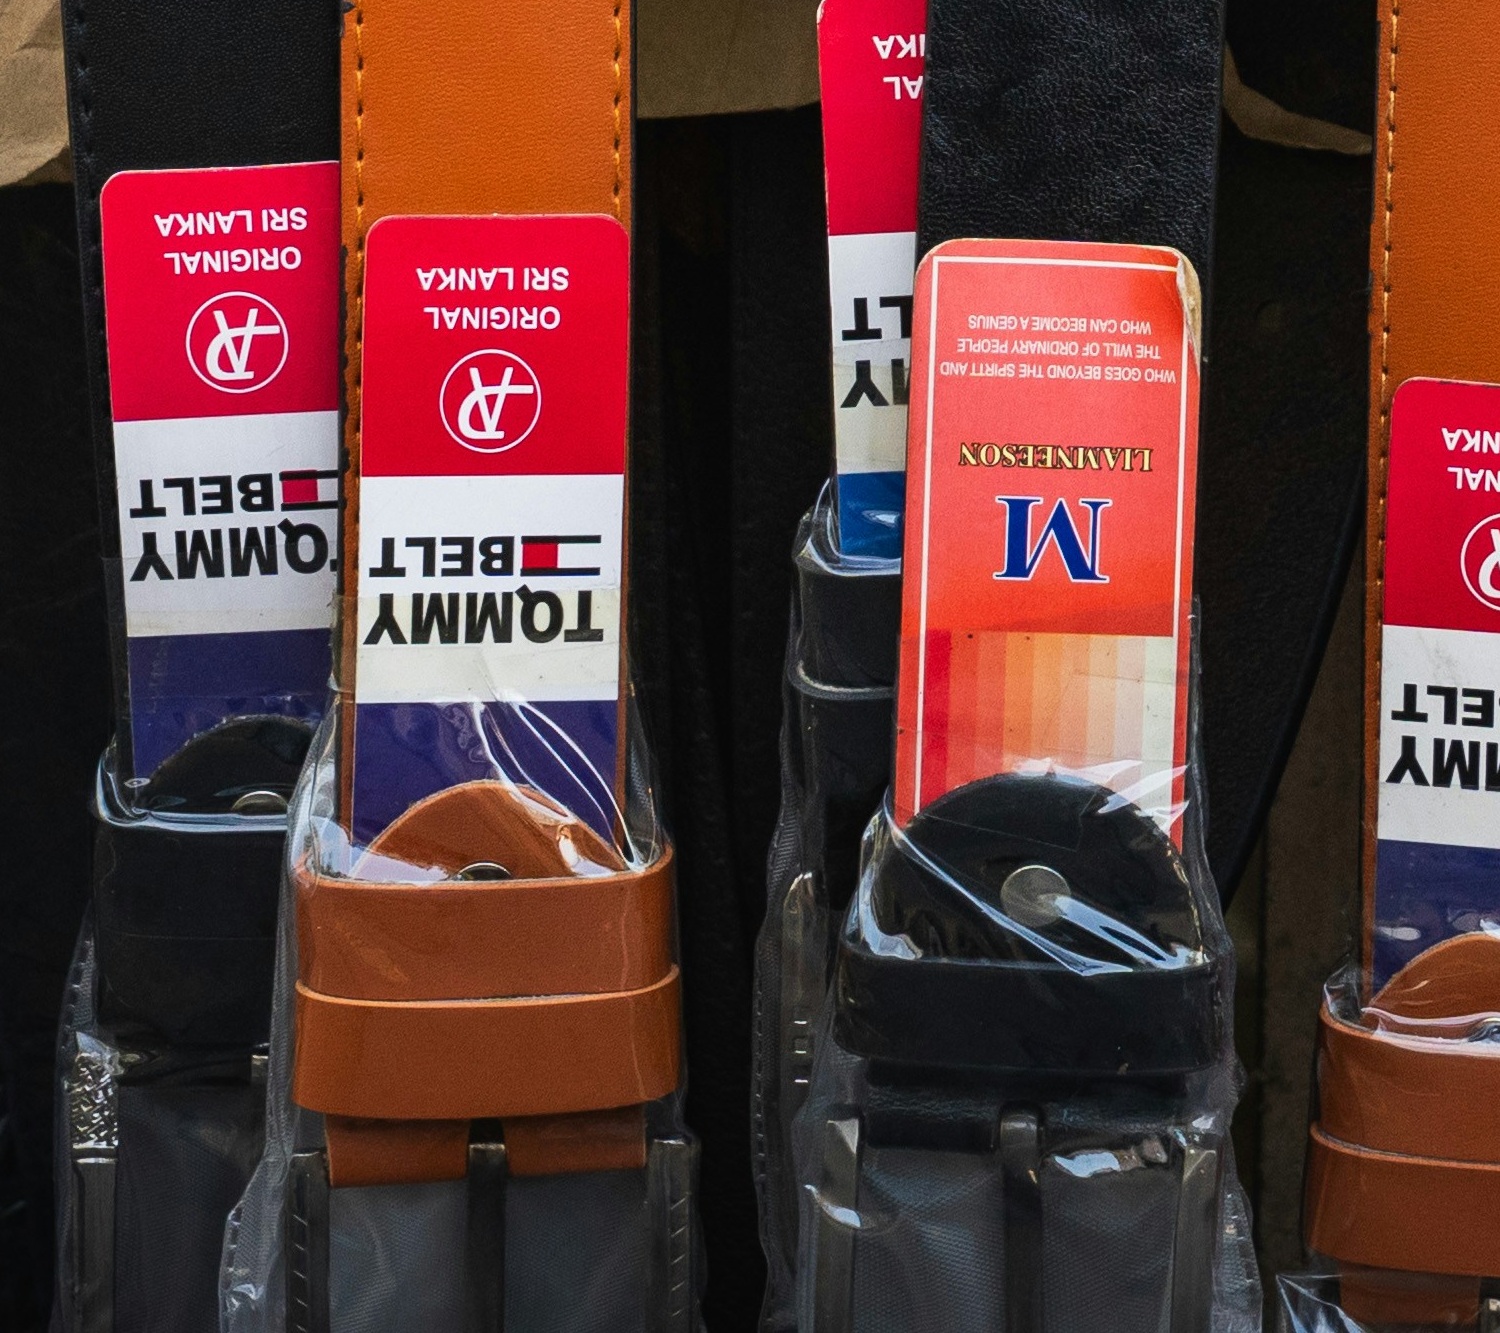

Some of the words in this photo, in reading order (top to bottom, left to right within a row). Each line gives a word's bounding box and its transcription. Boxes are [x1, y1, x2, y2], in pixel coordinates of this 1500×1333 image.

[154, 209, 254, 239] LANKA
[261, 205, 309, 234] SRI
[163, 244, 304, 274] ORIGINAL
[415, 265, 514, 291] LANKA
[519, 266, 570, 292] SRI
[422, 304, 562, 332] ORIGINAL
[968, 314, 1017, 330] GENIUS
[1019, 316, 1029, 330] A
[1031, 316, 1087, 332] BECOME
[1090, 318, 1117, 334] CAN
[1120, 320, 1151, 335] WHO
[957, 338, 1008, 353] PEOPLE
[1011, 339, 1079, 355] ORDINARY
[1081, 342, 1100, 357] OF
[1103, 342, 1133, 358] WILL
[1136, 344, 1161, 360] THE
[940, 361, 968, 375] AND
[1019, 364, 1044, 378] THE
[1047, 364, 1102, 380] BEYOND
[1104, 366, 1141, 381] GOES
[1144, 368, 1176, 384] WHO
[958, 440, 1154, 474] LIAMNEESON
[129, 471, 273, 517] BELT
[993, 493, 1112, 583] M
[368, 534, 515, 578] BELT
